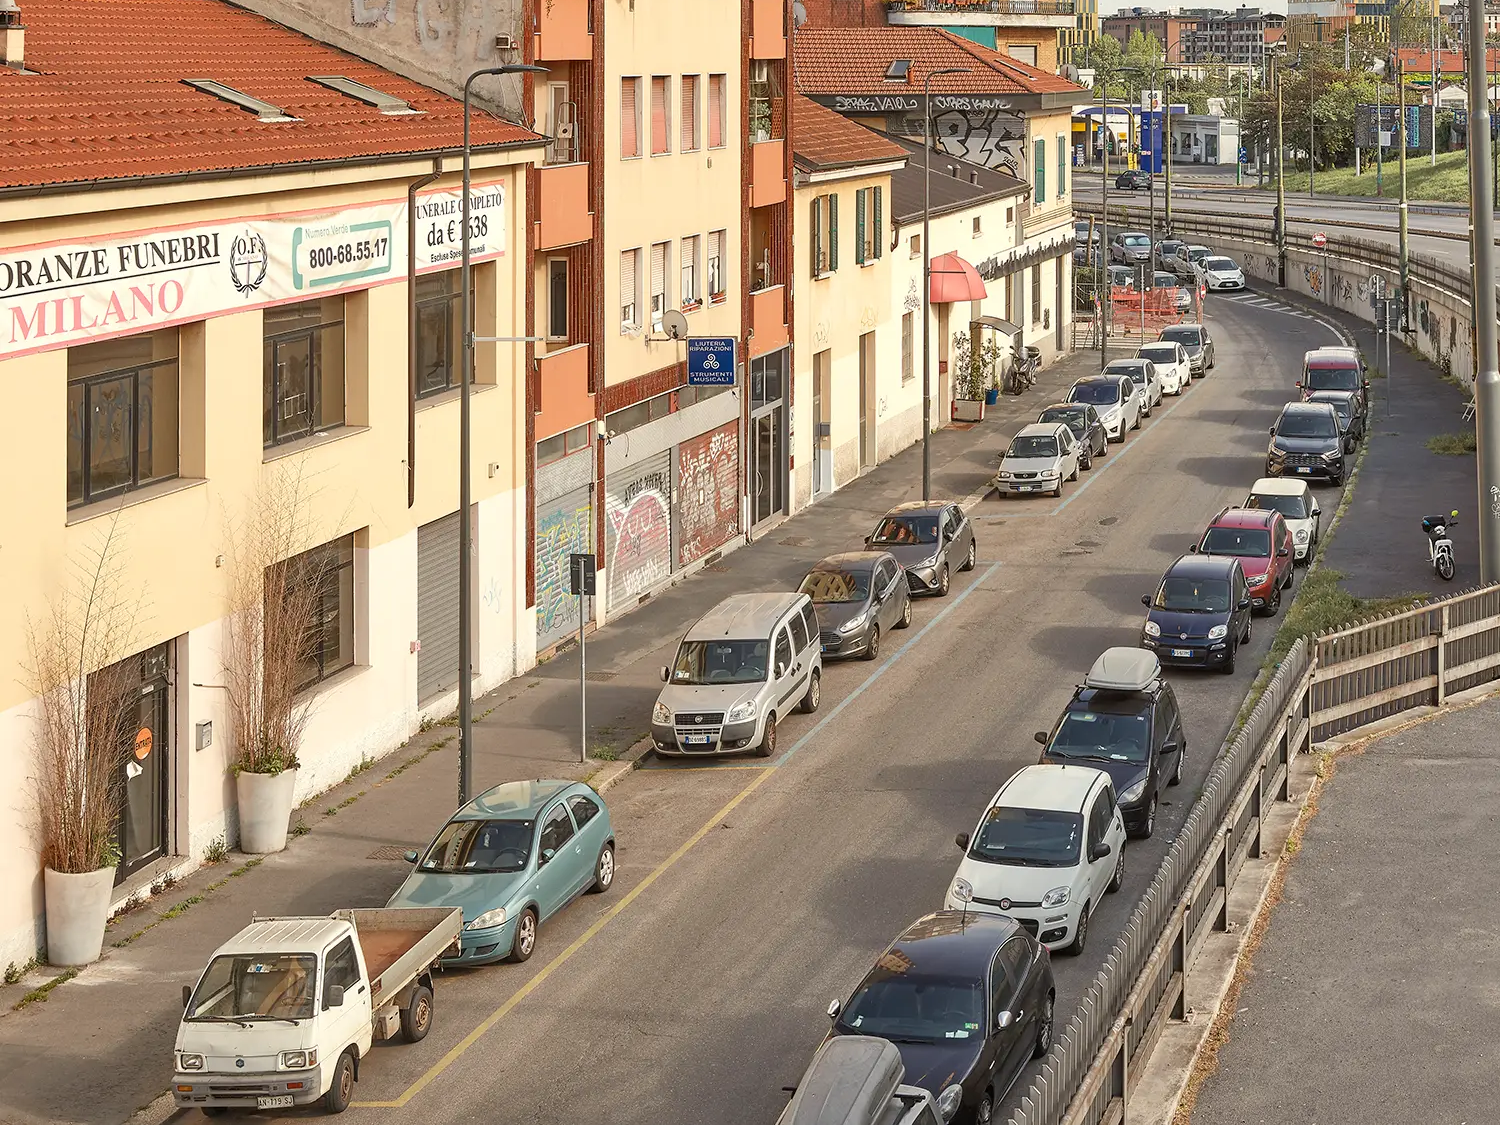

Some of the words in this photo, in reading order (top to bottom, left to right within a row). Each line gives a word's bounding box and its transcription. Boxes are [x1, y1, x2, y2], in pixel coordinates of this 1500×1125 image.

[415, 200, 456, 220] UNERALE
[458, 192, 502, 213] CMPLETO
[305, 227, 330, 239] Numero
[331, 224, 348, 236] Verde
[427, 222, 444, 247] da
[447, 220, 456, 243] €
[117, 232, 221, 273] FUNEBRI
[309, 237, 388, 269] 800-68.55.17
[8, 279, 184, 344] MILANO
